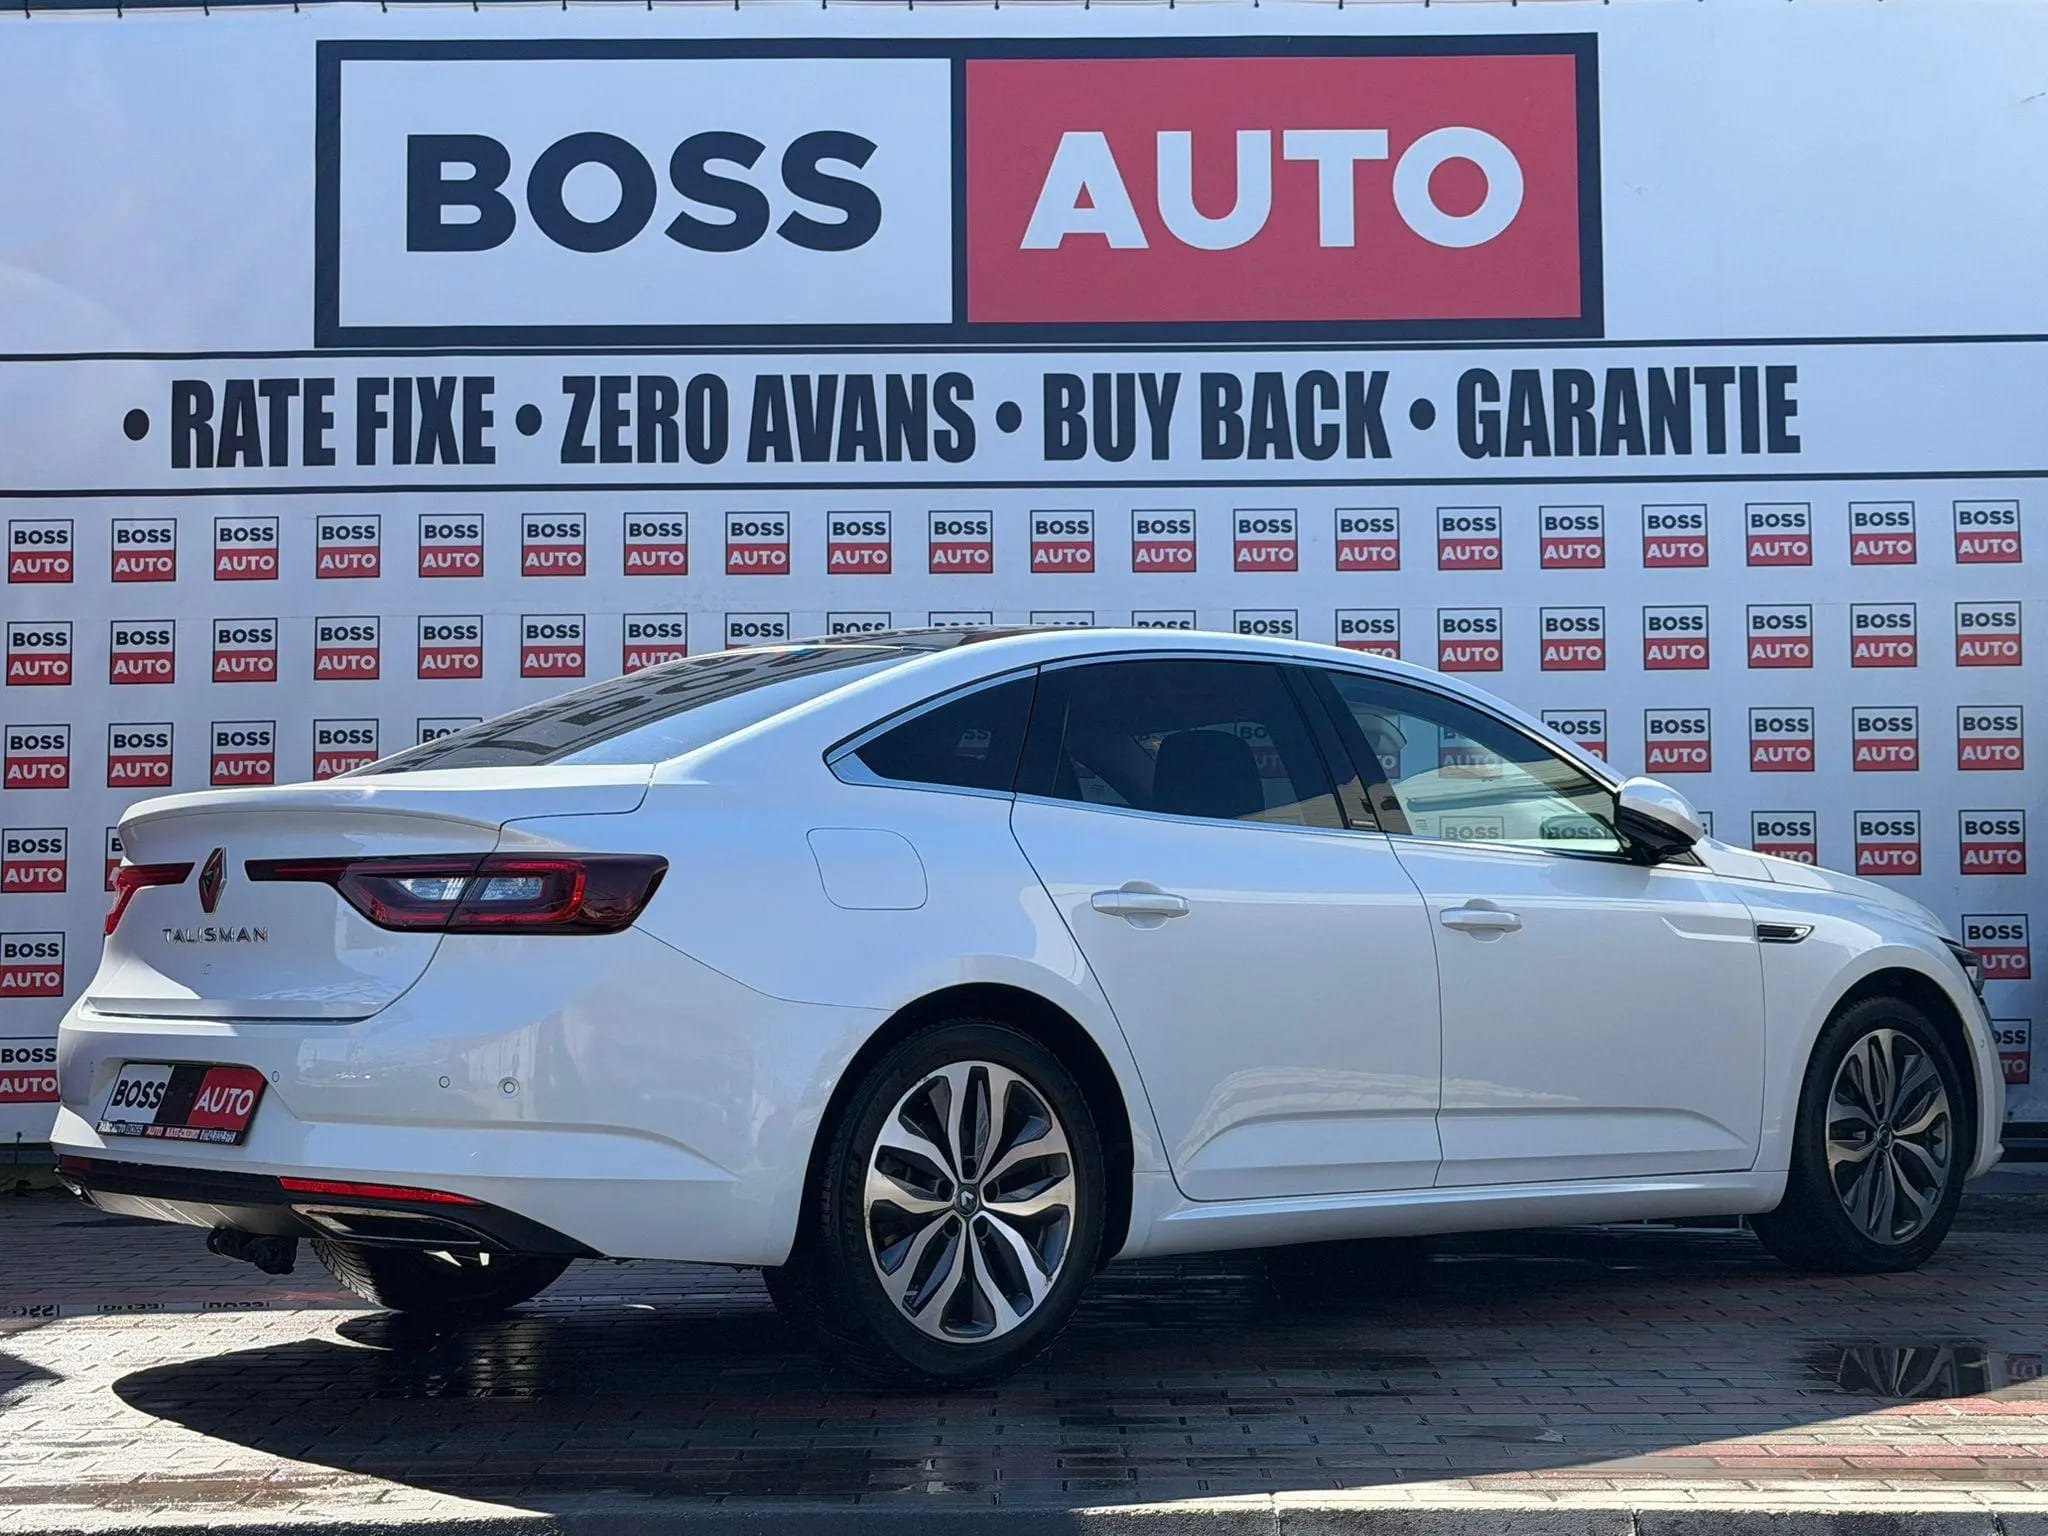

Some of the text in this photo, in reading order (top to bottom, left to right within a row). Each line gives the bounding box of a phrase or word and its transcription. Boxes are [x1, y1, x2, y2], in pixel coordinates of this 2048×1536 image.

[407, 127, 1524, 253] BOSS AUTO
[172, 366, 1800, 468] RATE FIXE ZERO AVANS BUY BACK GARANTIE
[1341, 518, 1394, 533] BOSS
[1443, 517, 1496, 532] BOSS
[1545, 516, 1599, 531] BOSS
[1648, 514, 1702, 530] BOSS
[1752, 513, 1805, 528] BOSS
[1855, 512, 1909, 527] BOSS
[1960, 510, 2014, 526] BOSS
[220, 527, 274, 542] BOSS
[322, 525, 375, 540] BOSS
[425, 524, 478, 539] BOSS
[528, 523, 581, 538] BOSS
[629, 522, 683, 538] BOSS
[731, 522, 785, 537] BOSS
[833, 521, 886, 536] BOSS
[934, 521, 988, 536] BOSS
[1036, 520, 1089, 535] BOSS
[1137, 520, 1191, 535] BOSS
[1239, 519, 1293, 534] BOSS
[14, 530, 68, 545] BOSS
[118, 528, 172, 544] BOSS
[1339, 546, 1395, 563] AUTO
[1442, 545, 1498, 562] AUTO
[1544, 543, 1600, 560] AUTO
[1647, 542, 1703, 559] AUTO
[1751, 541, 1807, 558] AUTO
[1855, 539, 1911, 556] AUTO
[1960, 538, 2016, 555] AUTO
[218, 555, 274, 572] AUTO
[320, 553, 376, 570] AUTO
[423, 552, 479, 569] AUTO
[525, 551, 581, 568] AUTO
[628, 549, 685, 567] AUTO
[729, 550, 785, 567] AUTO
[831, 549, 887, 566] AUTO
[933, 548, 989, 565] AUTO
[1034, 548, 1090, 565] AUTO
[1136, 547, 1192, 564] AUTO
[1238, 547, 1294, 564] AUTO
[12, 558, 68, 575] AUTO
[116, 557, 172, 574] AUTO
[1239, 620, 1293, 635] BOSS
[1341, 619, 1395, 634] BOSS
[1444, 618, 1497, 633] BOSS
[1546, 617, 1599, 632] BOSS
[1649, 616, 1703, 631] BOSS
[1753, 614, 1807, 630] BOSS
[1857, 613, 1911, 629] BOSS
[1962, 612, 2016, 628] BOSS
[219, 628, 273, 644] BOSS
[321, 626, 374, 641] BOSS
[424, 625, 477, 640] BOSS
[527, 624, 580, 639] BOSS
[629, 623, 682, 638] BOSS
[731, 622, 784, 637] BOSS
[13, 632, 67, 647] BOSS
[116, 630, 170, 646] BOSS
[1442, 646, 1498, 663] AUTO
[1545, 644, 1602, 662] AUTO
[1648, 644, 1704, 661] AUTO
[1752, 643, 1808, 660] AUTO
[1856, 641, 1913, 659] AUTO
[1961, 640, 2018, 658] AUTO
[11, 659, 68, 677] AUTO
[114, 658, 170, 675] AUTO
[217, 656, 274, 674] AUTO
[319, 653, 376, 671] AUTO
[422, 653, 478, 670] AUTO
[525, 651, 582, 669] AUTO
[1651, 719, 1705, 734] BOSS
[1755, 718, 1809, 733] BOSS
[1859, 717, 1912, 732] BOSS
[1964, 716, 2017, 731] BOSS
[11, 735, 64, 750] BOSS
[114, 733, 168, 749] BOSS
[217, 731, 271, 747] BOSS
[319, 729, 373, 745] BOSS
[1650, 747, 1706, 764] AUTO
[1754, 746, 1810, 763] AUTO
[1858, 744, 1915, 762] AUTO
[1963, 744, 2020, 762] AUTO
[9, 762, 66, 780] AUTO
[112, 761, 169, 779] AUTO
[214, 760, 270, 777] AUTO
[1445, 826, 1499, 840] BOSS
[1757, 822, 1811, 837] BOSS
[1861, 821, 1915, 836] BOSS
[1966, 820, 2020, 836] BOSS
[8, 838, 62, 854] BOSS
[1860, 849, 1916, 866] AUTO
[1965, 848, 2022, 866] AUTO
[6, 866, 63, 884] AUTO
[162, 927, 268, 943] TALISMAN
[1968, 925, 2022, 940] BOSS
[5, 942, 59, 958] BOSS
[1982, 954, 2026, 970] UTO
[3, 970, 60, 988] AUTO
[2, 1047, 56, 1063] BOSS
[0, 1077, 57, 1093] AUTO
[111, 1080, 255, 1116] BOSS AUTO
